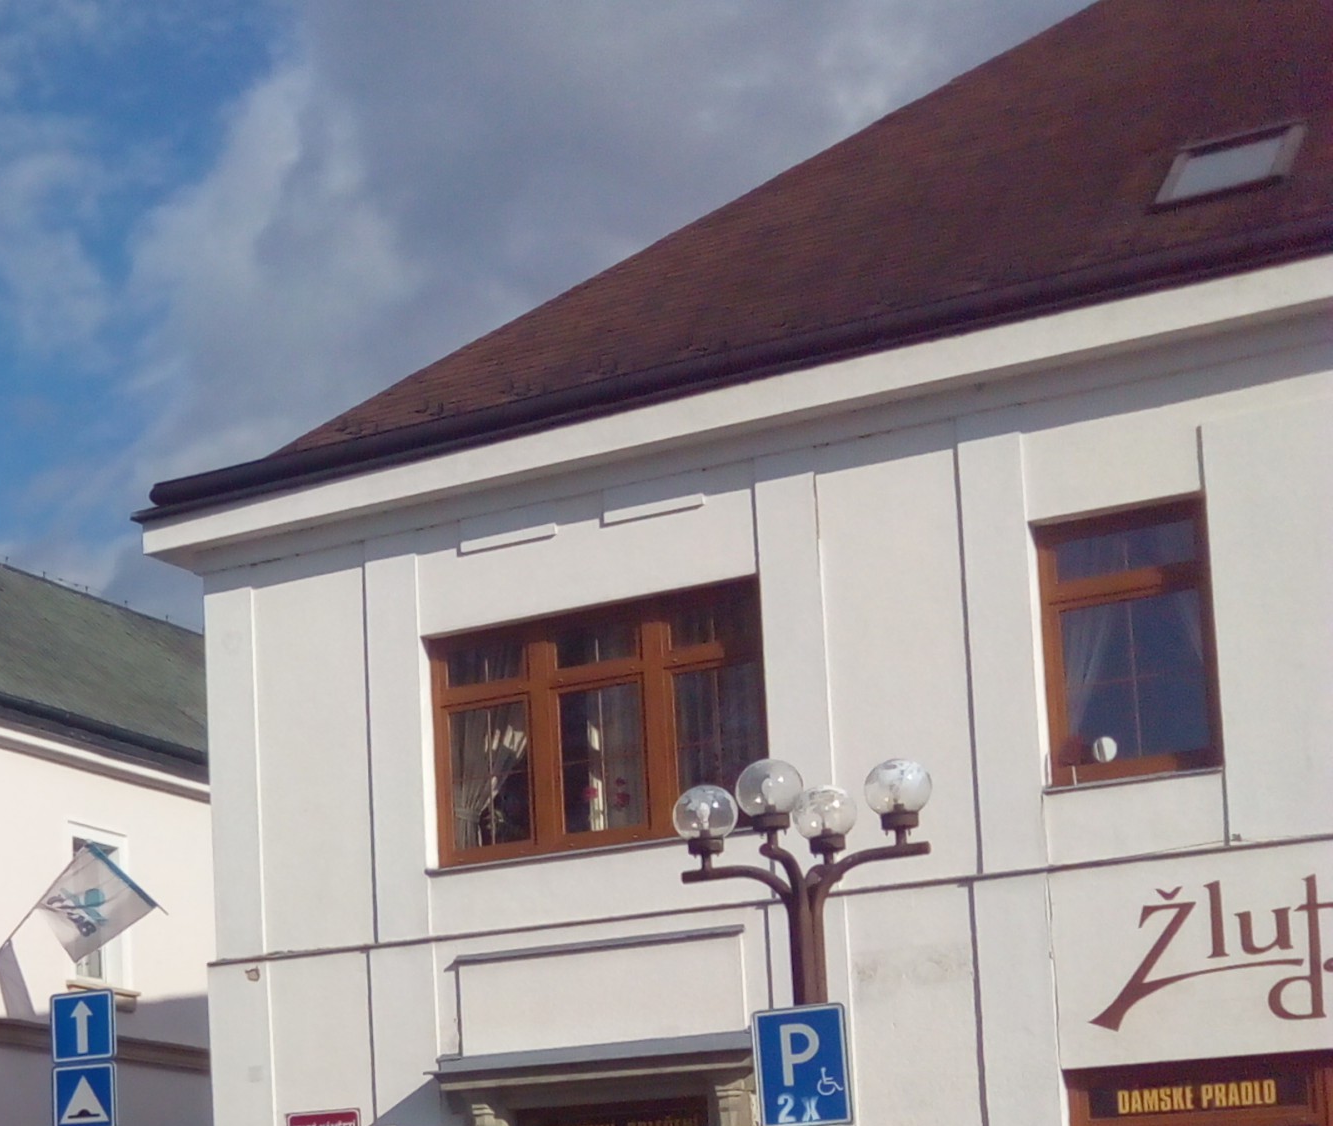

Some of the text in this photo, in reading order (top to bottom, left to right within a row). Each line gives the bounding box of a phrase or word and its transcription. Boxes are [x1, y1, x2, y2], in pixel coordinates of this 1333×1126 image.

[1088, 874, 1333, 1032] Žlut
[779, 1023, 820, 1087] P
[777, 1093, 796, 1124] 2
